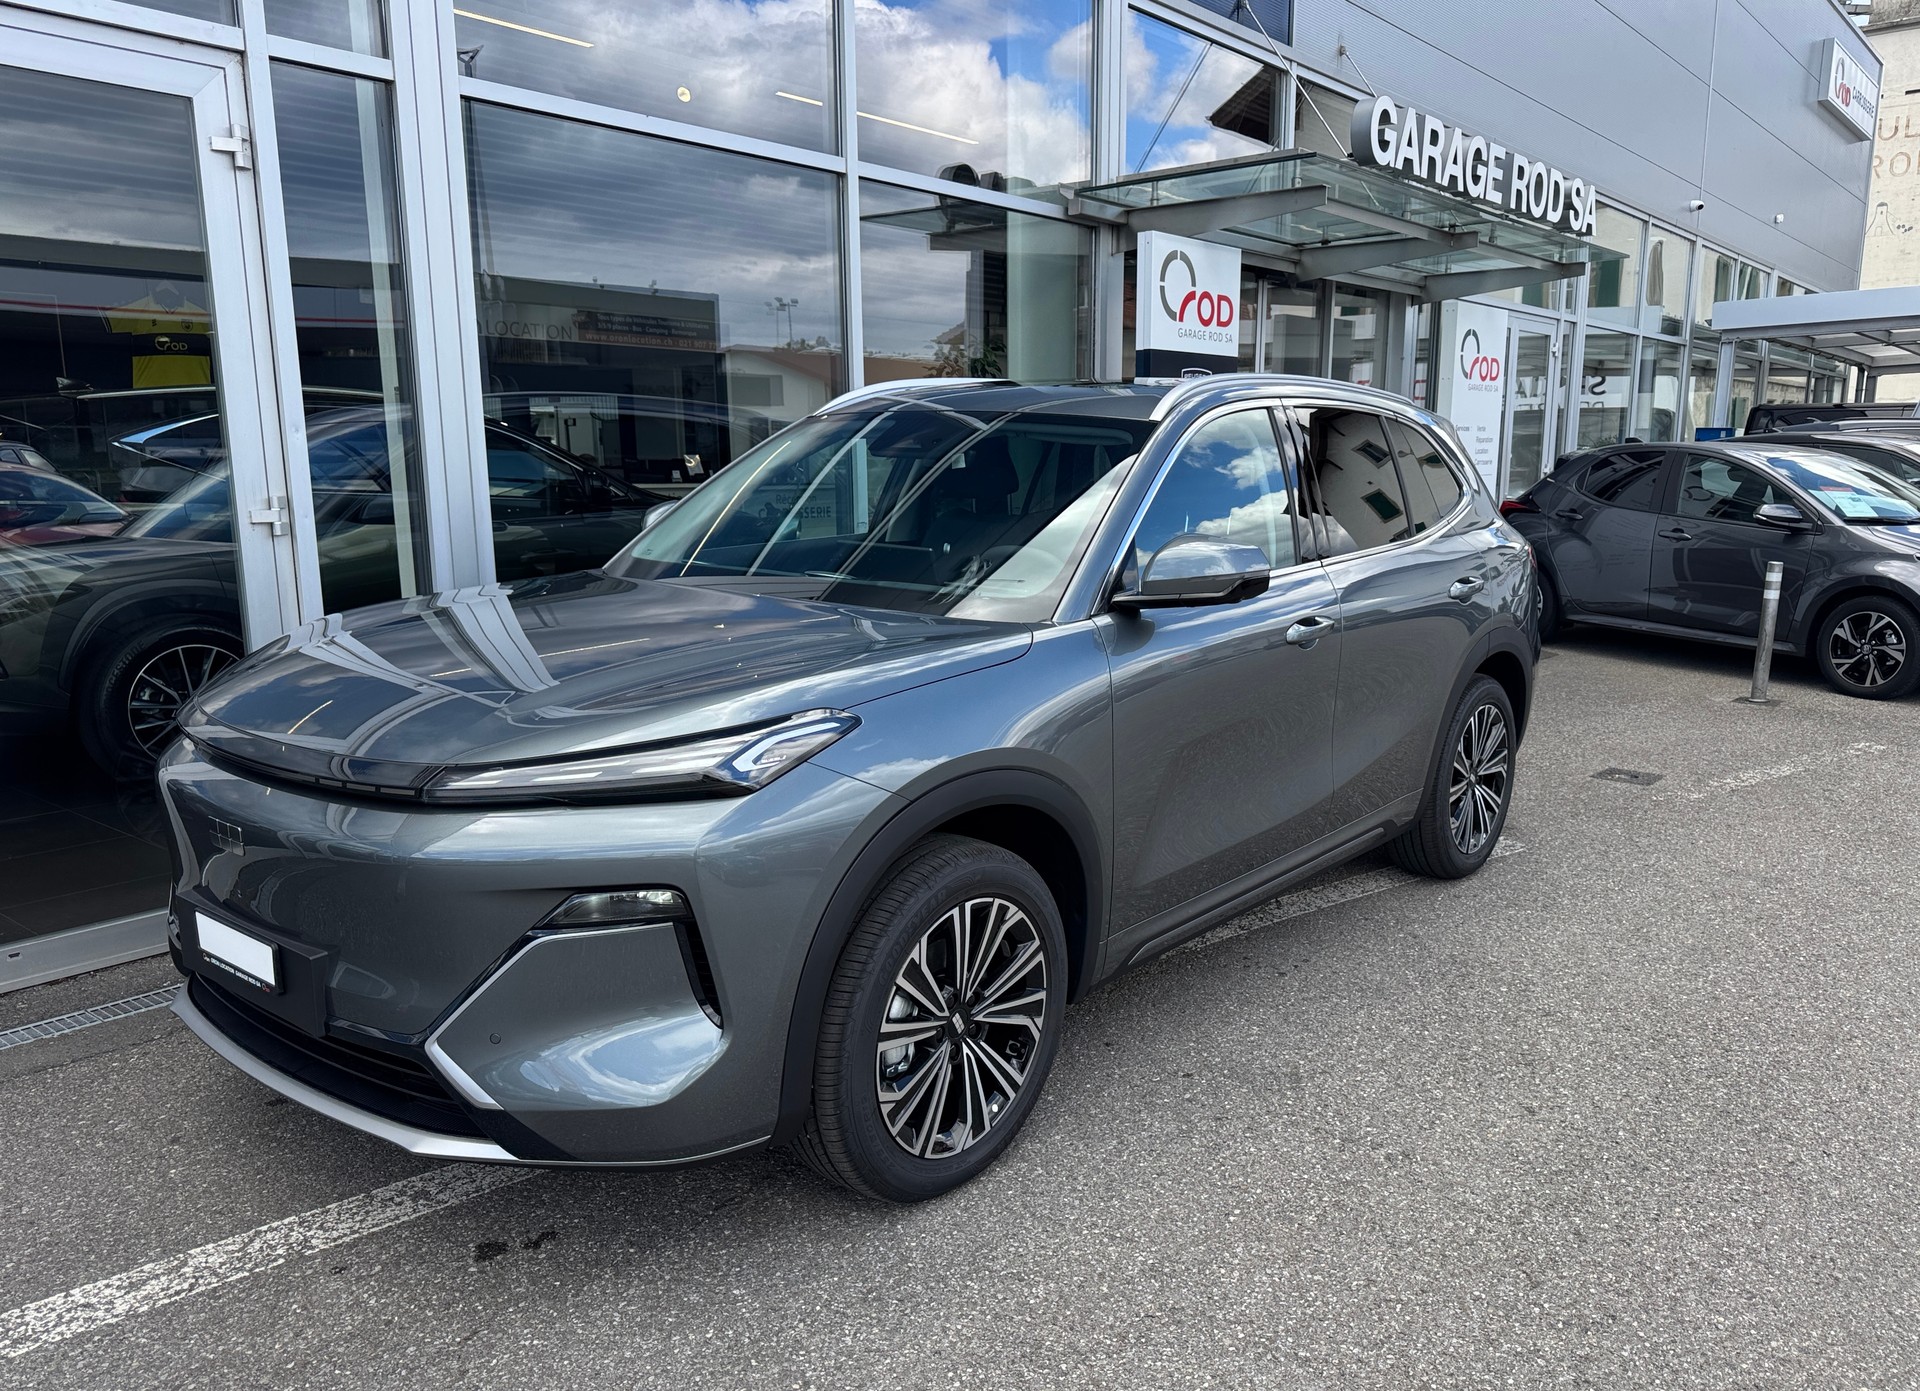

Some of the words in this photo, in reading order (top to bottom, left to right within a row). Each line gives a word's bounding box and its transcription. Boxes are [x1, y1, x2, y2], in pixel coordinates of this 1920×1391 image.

[1370, 95, 1506, 204] GARAGE
[1510, 153, 1565, 223] ROD
[1569, 178, 1597, 236] SA
[486, 319, 573, 340] LOCATION
[1177, 327, 1207, 341] GARAGE
[1208, 331, 1223, 342] ROD
[1224, 333, 1233, 343] SA
[1467, 383, 1484, 391] GARAGE
